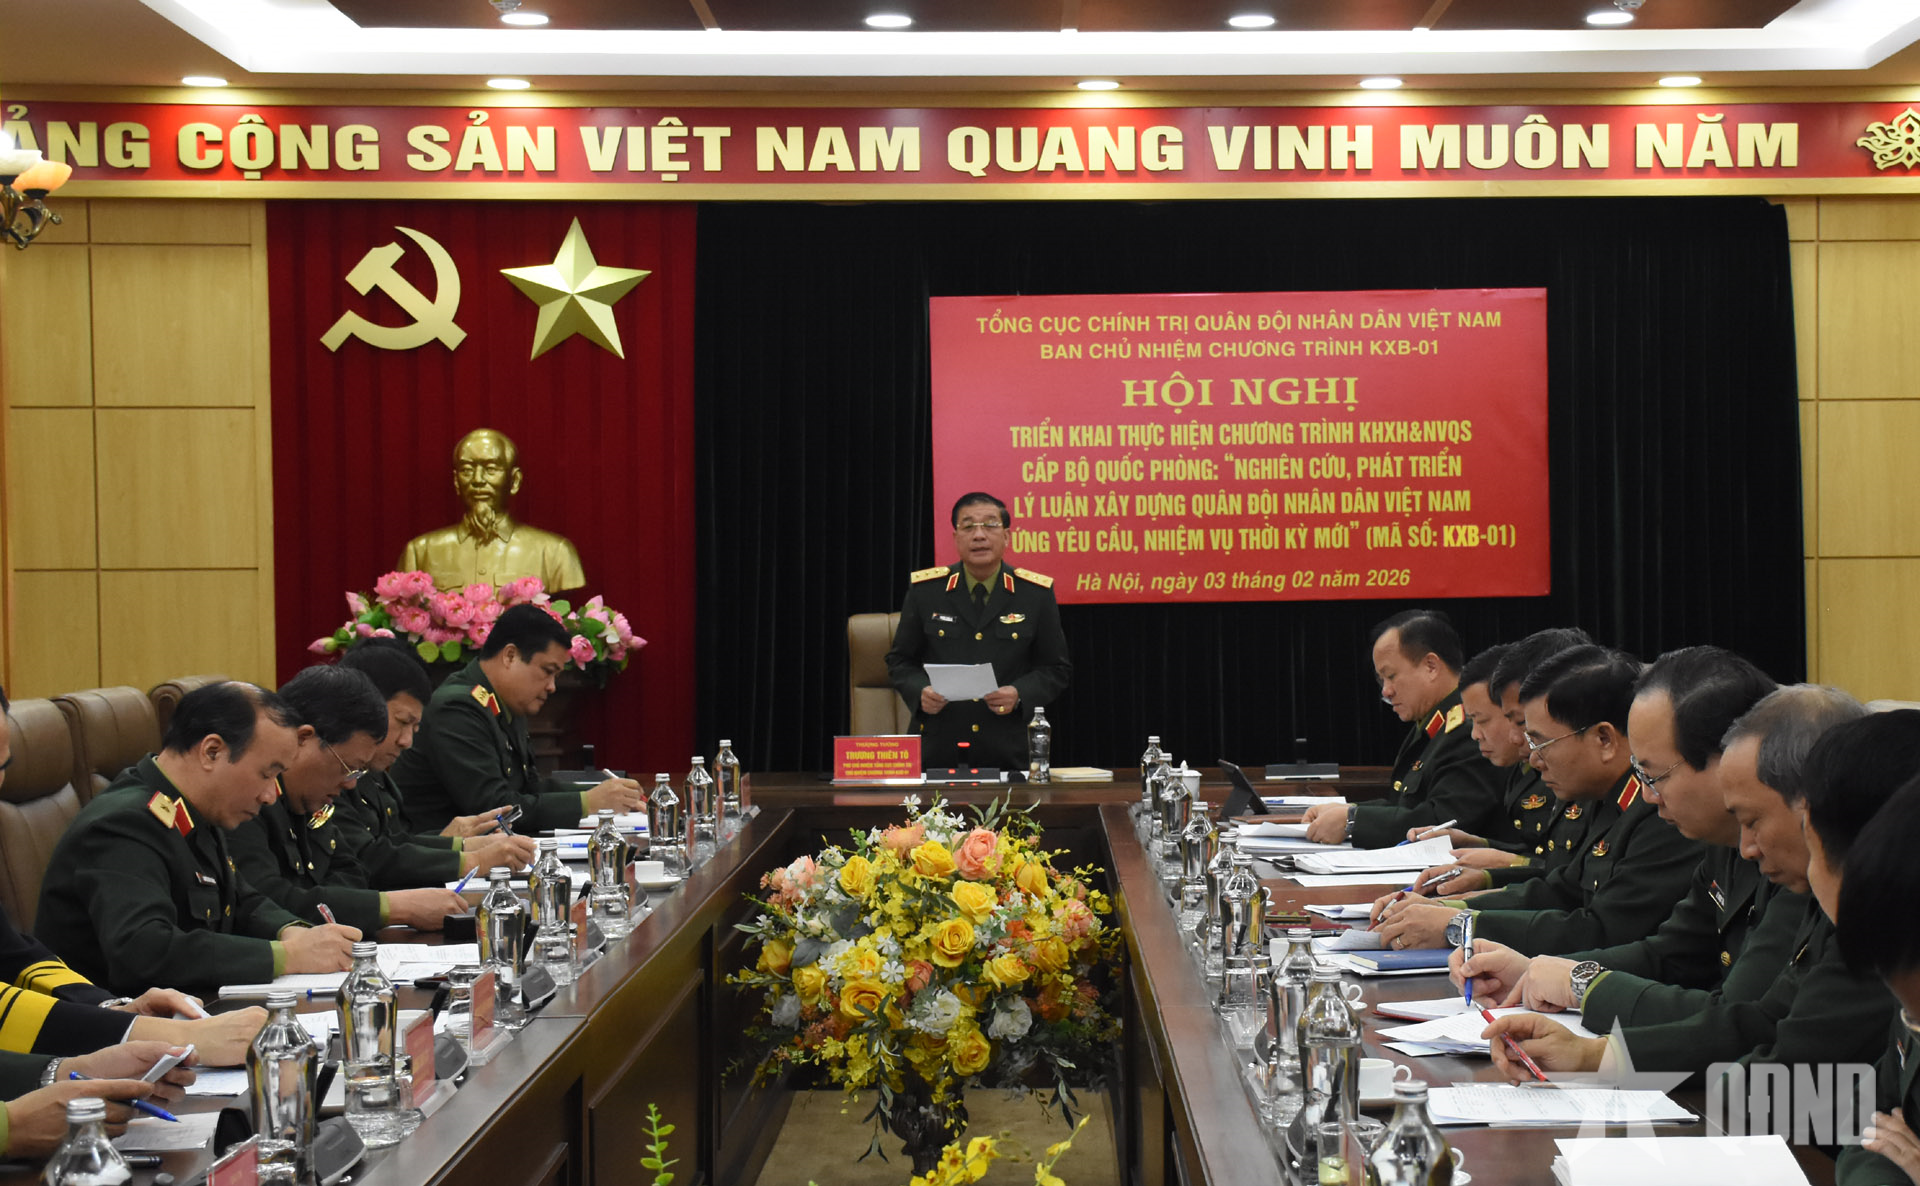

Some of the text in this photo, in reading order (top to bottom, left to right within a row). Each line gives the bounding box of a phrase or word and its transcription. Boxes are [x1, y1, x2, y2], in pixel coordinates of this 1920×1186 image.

[177, 113, 380, 180] CỘNG
[407, 110, 556, 172] SẢN
[580, 117, 731, 181] VIỆT
[756, 126, 921, 172] NAM
[947, 126, 1184, 177] QUANG
[1207, 125, 1374, 171] VINH
[1400, 114, 1610, 169] MUÔN
[1635, 113, 1799, 168] NĂM
[975, 307, 1502, 337] TỔNG CỤC CHÍNH TRỊ QUÂN ĐỘI NHÂN DÂN VIỆT NAM
[1040, 336, 1439, 361] BAN CHỦ NHIỆM CHƯƠNG TRÌNH KXB-01
[1121, 370, 1359, 415] HỘI NGHỊ
[1009, 417, 1473, 452] TRIỂN KHAI THỰC HIỆN CHƯƠNG TRÌNH KHXH&NVQS
[1021, 446, 1462, 488] CẤP BỘ QUỐC PHÒNG: “NGHIÊN CỨU, PHÁT TRIỂN
[1013, 486, 1471, 523] LÝ LUẬN XÂY DỰNG QUÂN ĐỘI NHÂN DÂN VIỆT NAM
[1010, 517, 1517, 556] ỨNG YÊU CẦU, NHIỆM VỤ THỜI KỲ MỚI” (MÃ SỐ: KXB-01)
[1076, 568, 1411, 595] Hà Nội, ngày 03 tháng 02 năm 2026
[876, 749, 898, 760] THIÊN
